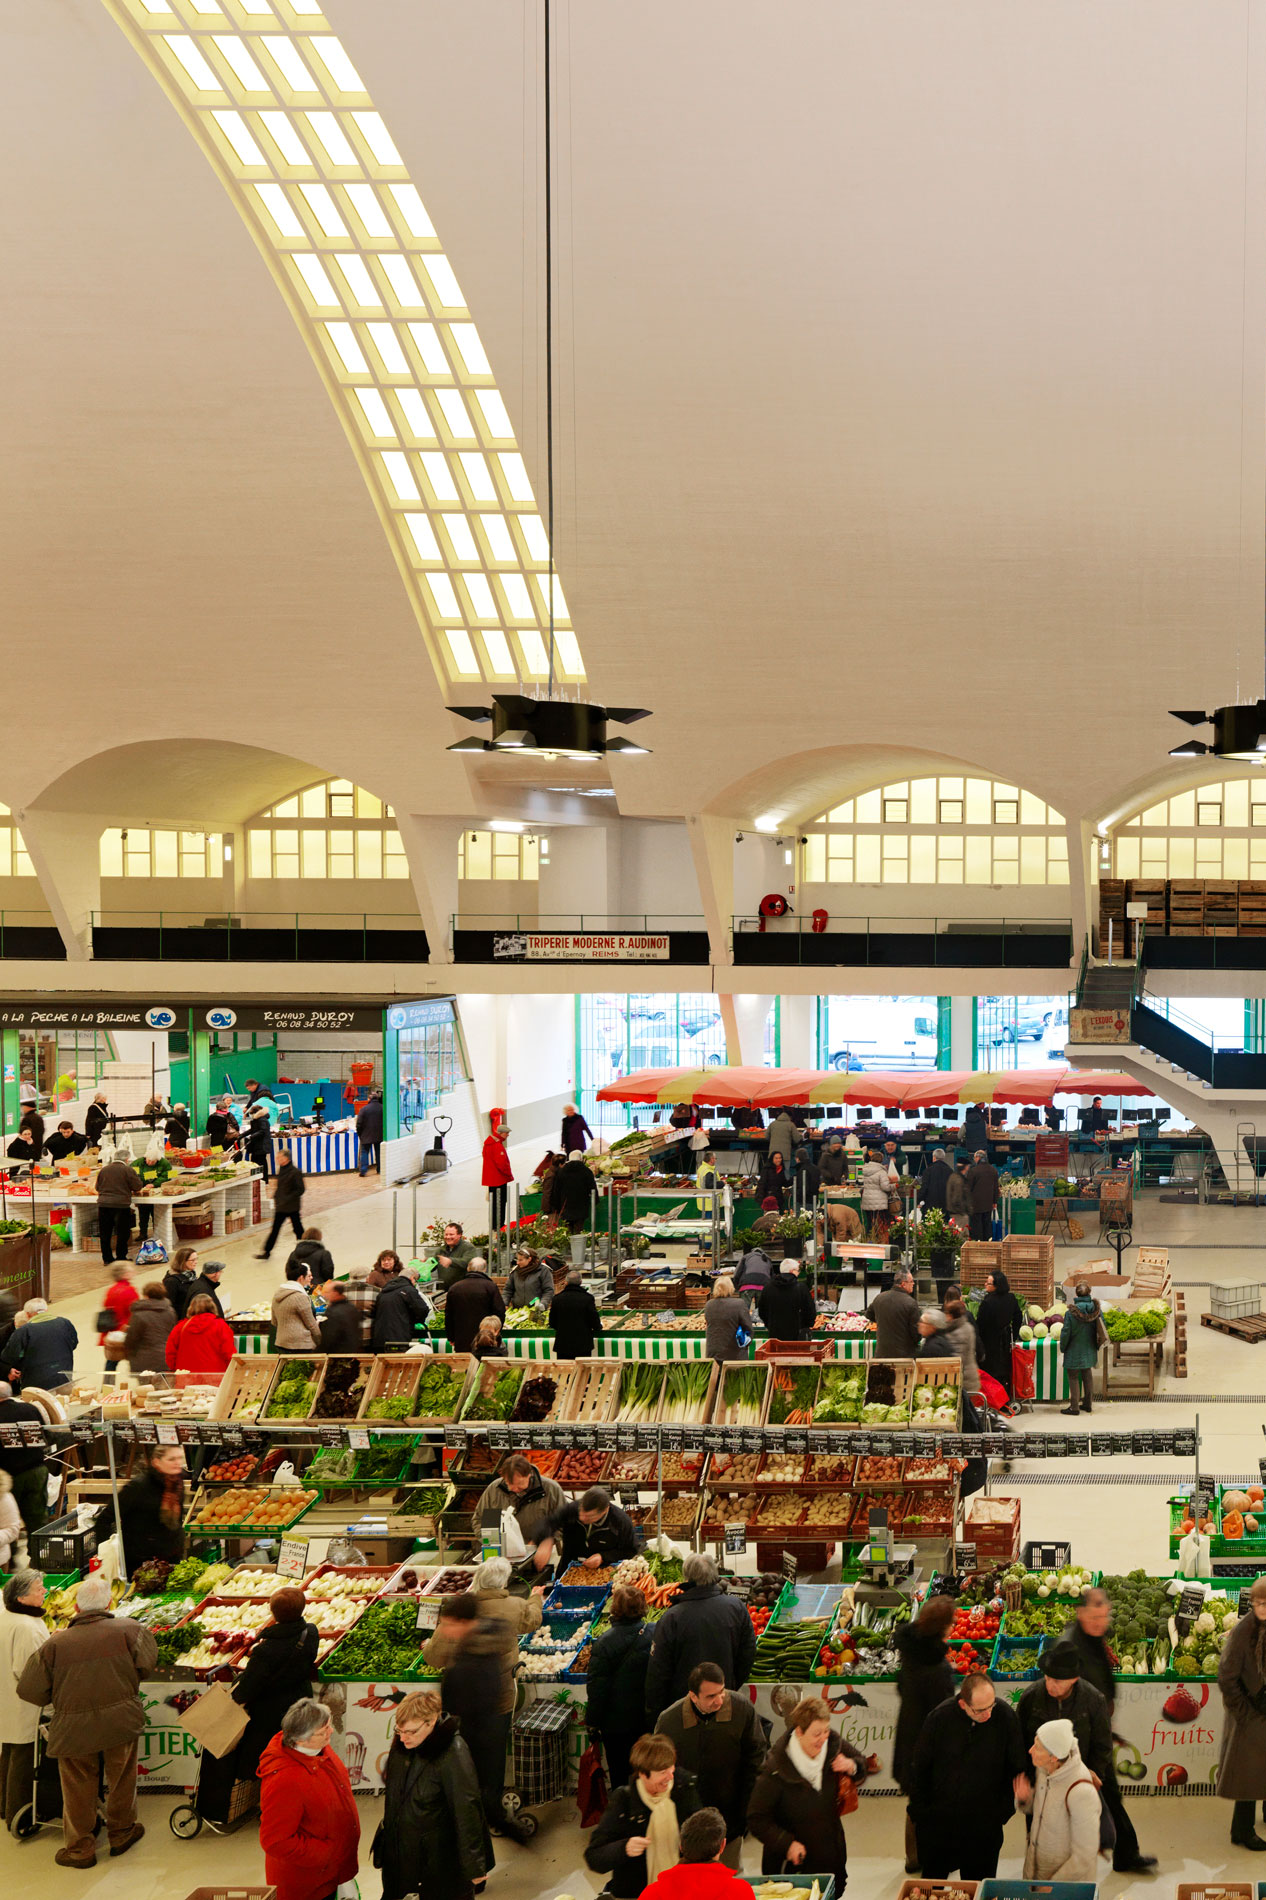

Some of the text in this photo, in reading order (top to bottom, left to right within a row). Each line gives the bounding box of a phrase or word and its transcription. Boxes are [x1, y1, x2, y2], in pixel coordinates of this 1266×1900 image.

[529, 936, 668, 950] TRIPERIE MODERNE R.AUDINOT
[592, 950, 620, 958] REIMS
[2, 1012, 140, 1024] A LA PECHE A LA BALEINE
[264, 1012, 354, 1022] RENAUD DUROY
[282, 1541, 307, 1551] Endive
[289, 1550, 305, 1558] France
[1144, 1720, 1215, 1756] fruits
